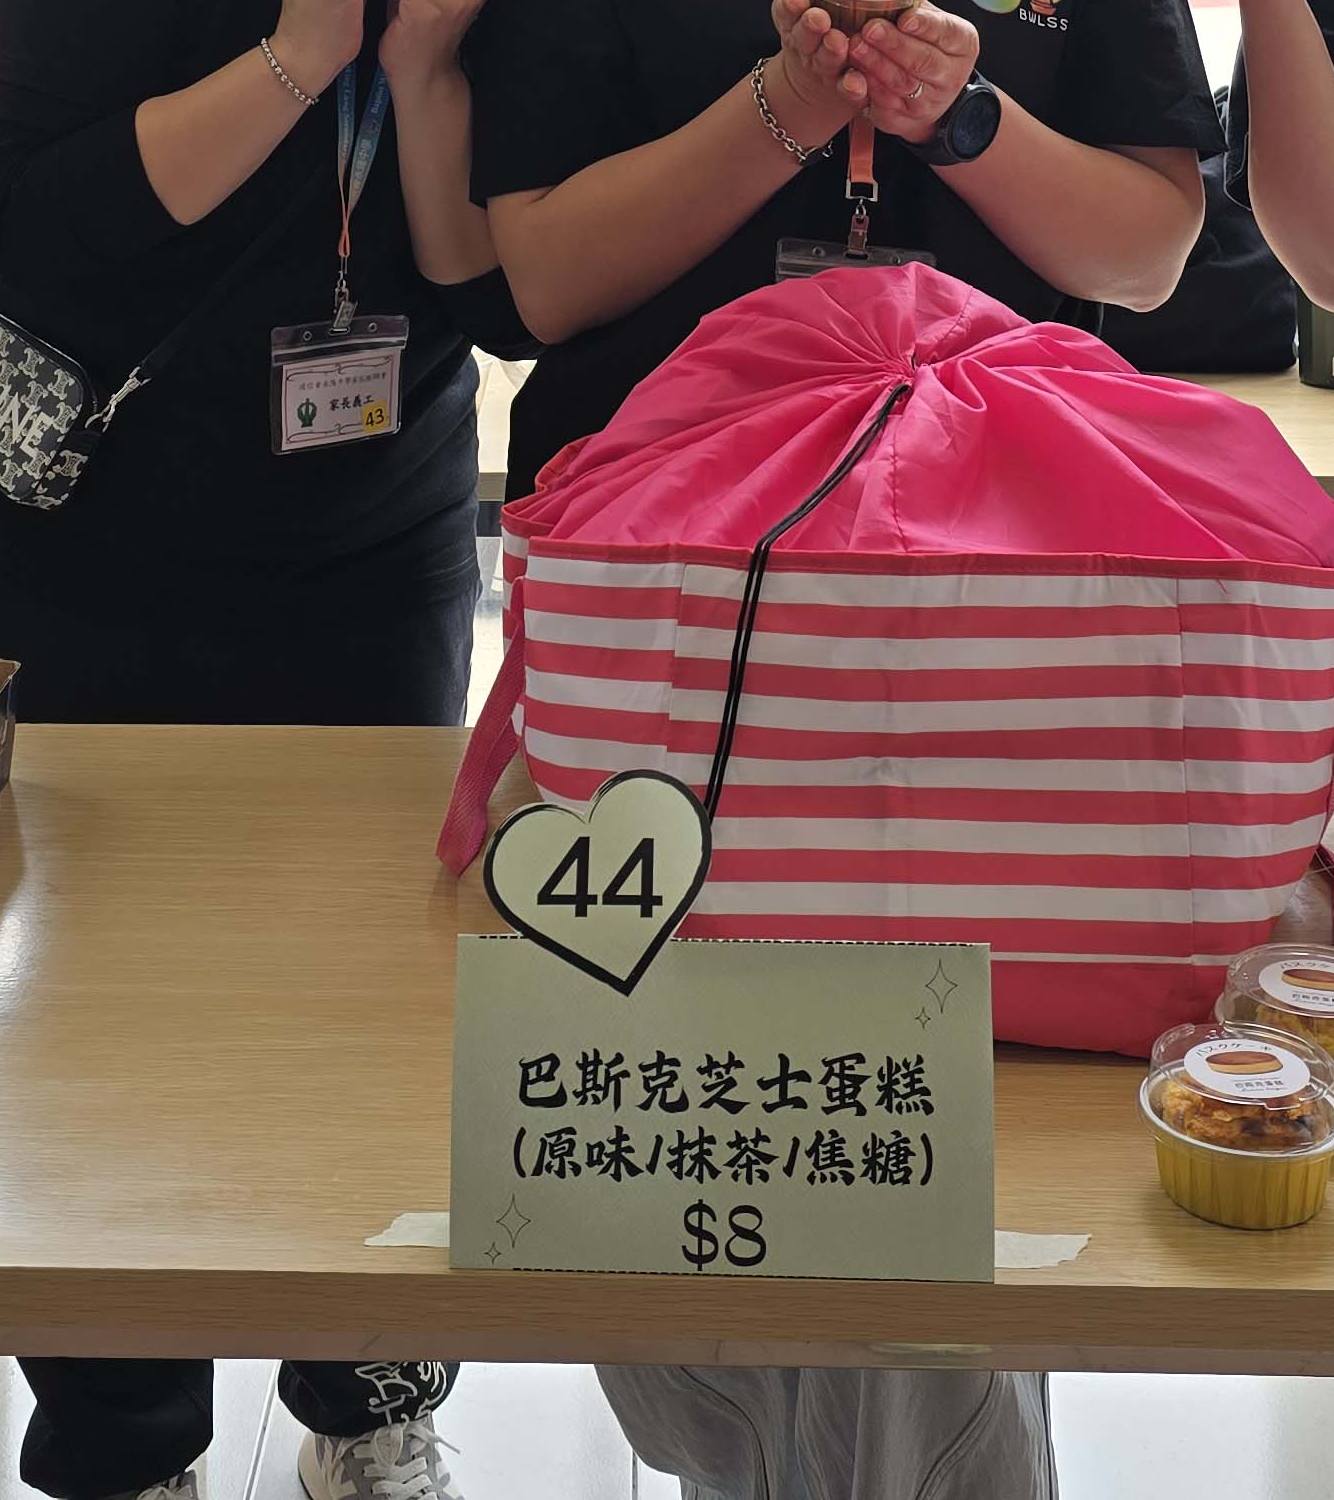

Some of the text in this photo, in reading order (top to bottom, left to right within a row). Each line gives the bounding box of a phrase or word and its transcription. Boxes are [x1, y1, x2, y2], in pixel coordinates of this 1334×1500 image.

[1019, 8, 1069, 31] BWLSS
[365, 409, 385, 428] 43
[537, 837, 663, 919] 44
[517, 1048, 935, 1117] 巴斯克芝士蛋糕
[513, 1125, 934, 1187] (原味/抹茶/焦糖)
[681, 1199, 766, 1271] $8
